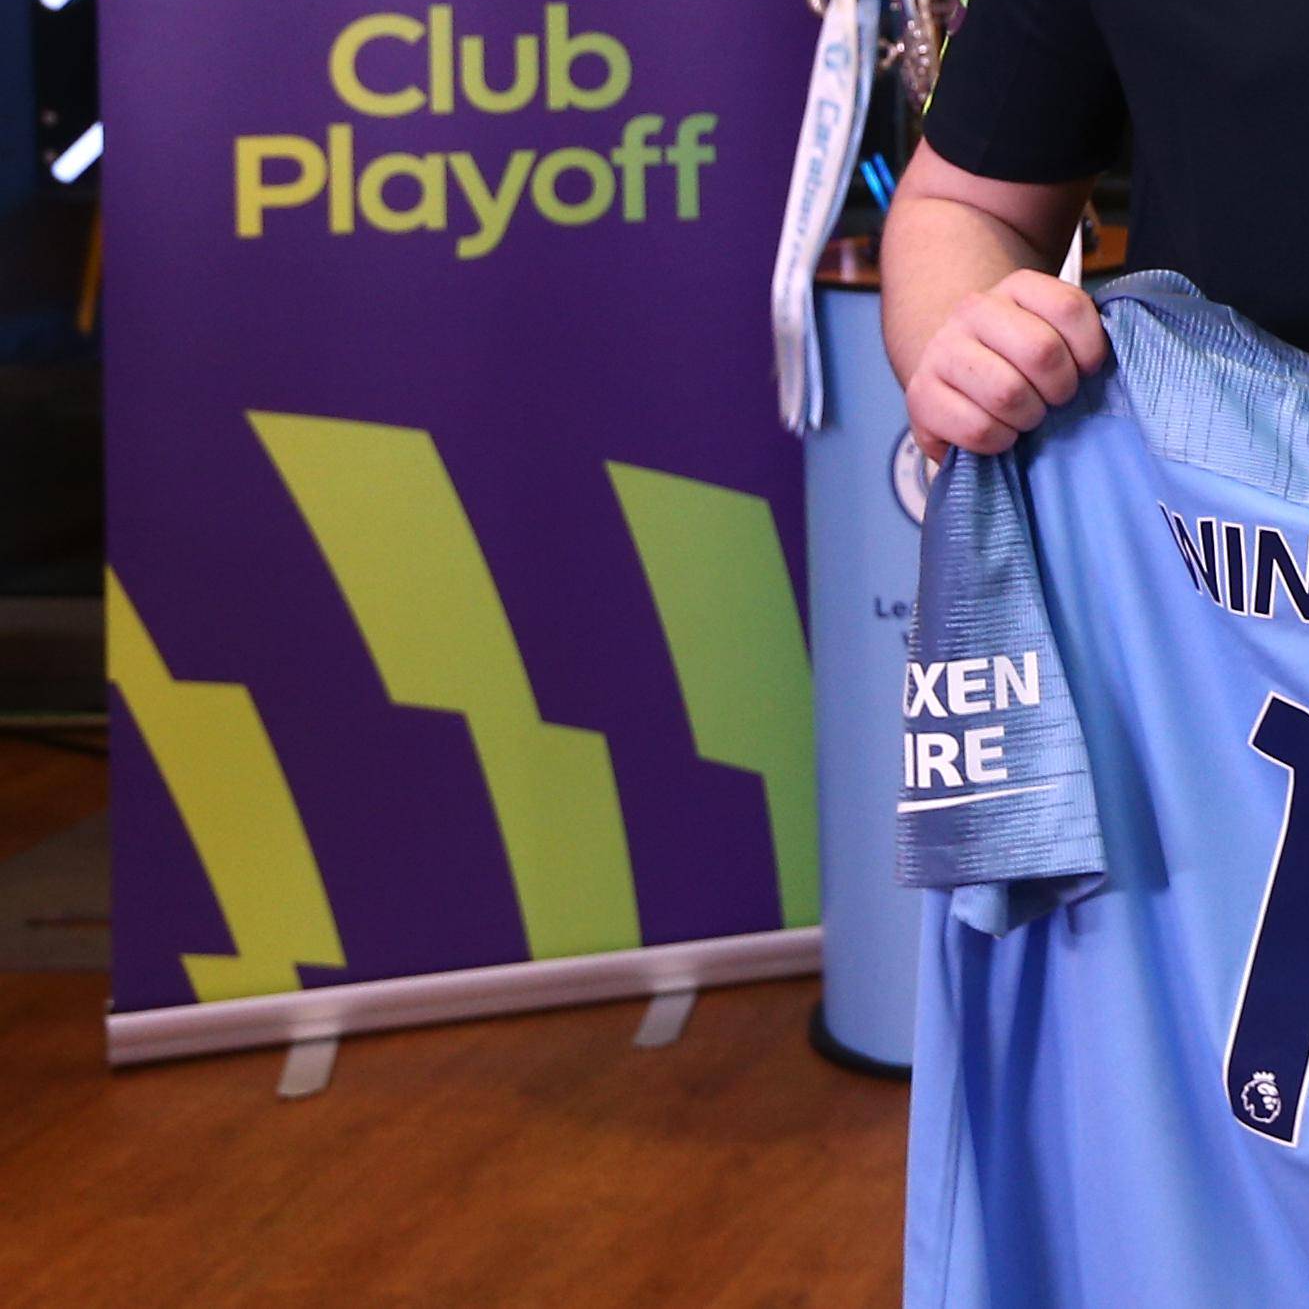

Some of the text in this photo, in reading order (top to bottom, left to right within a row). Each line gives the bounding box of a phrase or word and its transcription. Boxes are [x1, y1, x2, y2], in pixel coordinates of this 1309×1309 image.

[328, 2, 633, 118] Club
[233, 113, 718, 261] Playoff
[903, 651, 1041, 719] XEN
